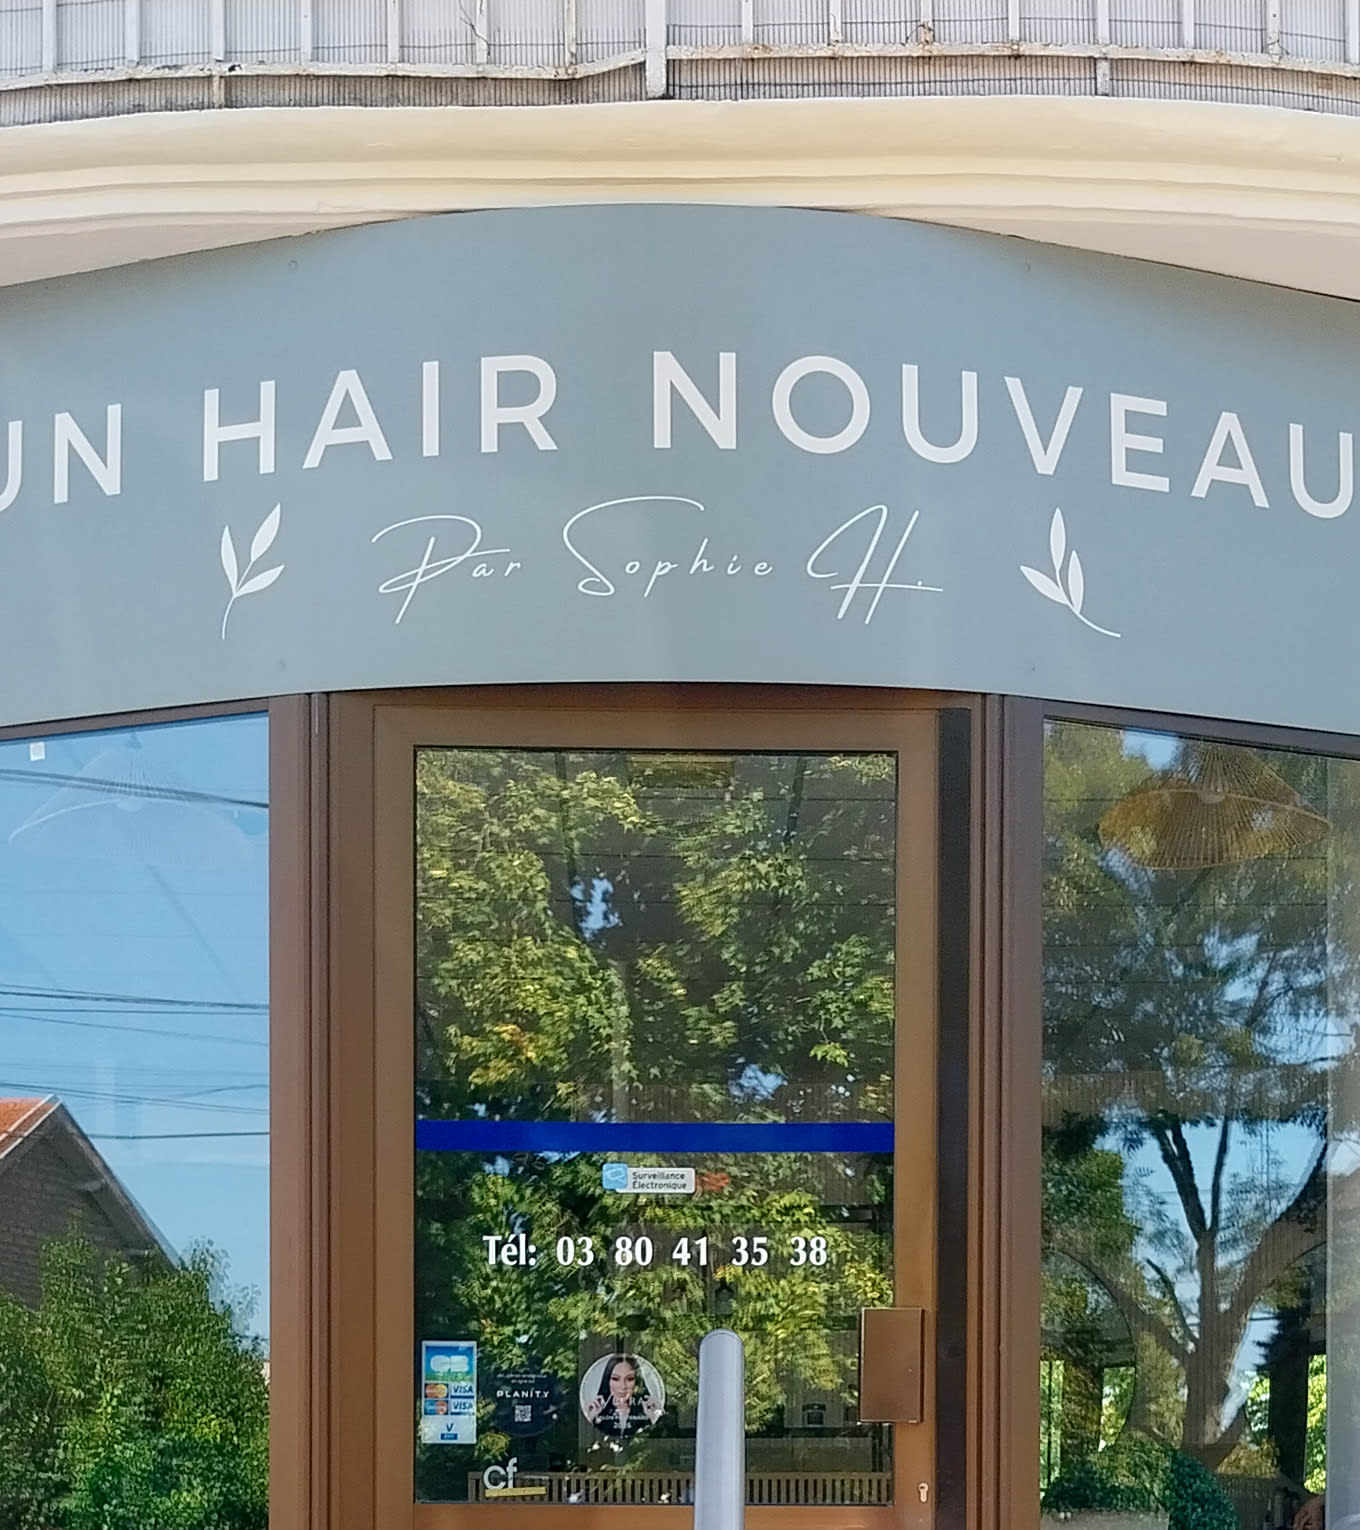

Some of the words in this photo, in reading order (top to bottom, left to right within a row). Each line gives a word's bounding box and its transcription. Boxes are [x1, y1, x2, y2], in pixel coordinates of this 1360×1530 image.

[202, 354, 558, 483] HAIR
[652, 350, 1354, 519] NOUVEAU
[371, 514, 522, 624] Par
[562, 496, 773, 597] Sophie
[632, 1171, 686, 1180] Surveillance
[482, 1233, 537, 1267] Tél:
[556, 1236, 595, 1267] 03
[614, 1236, 654, 1267] 80
[671, 1236, 709, 1267] 41
[730, 1236, 769, 1267] 35
[789, 1236, 828, 1267] 38
[453, 1385, 474, 1394] VISA
